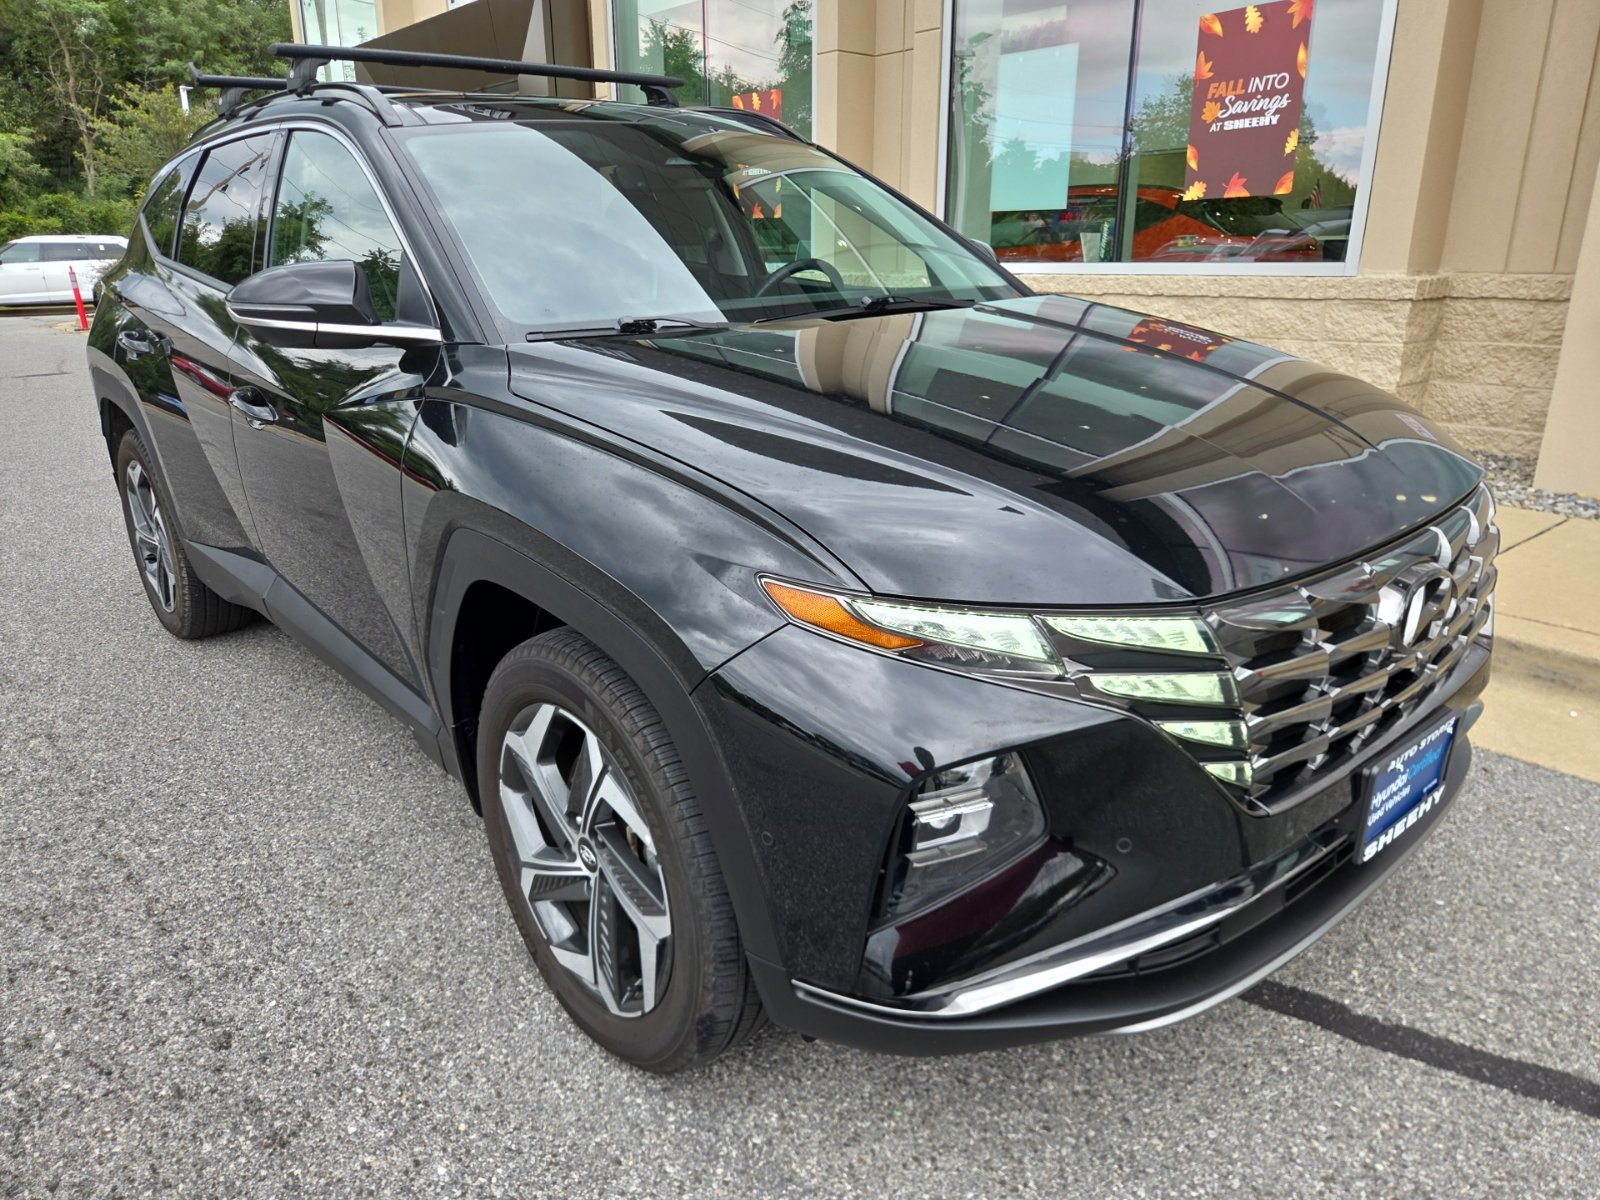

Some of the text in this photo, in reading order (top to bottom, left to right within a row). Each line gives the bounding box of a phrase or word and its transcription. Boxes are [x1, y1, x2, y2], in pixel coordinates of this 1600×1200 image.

[1207, 72, 1290, 99] FALL INTO
[1217, 93, 1291, 118] Savings
[1209, 115, 1280, 133] AT SHEEHY
[1387, 745, 1418, 772] AUTO
[1363, 783, 1446, 862] SHEEHY
